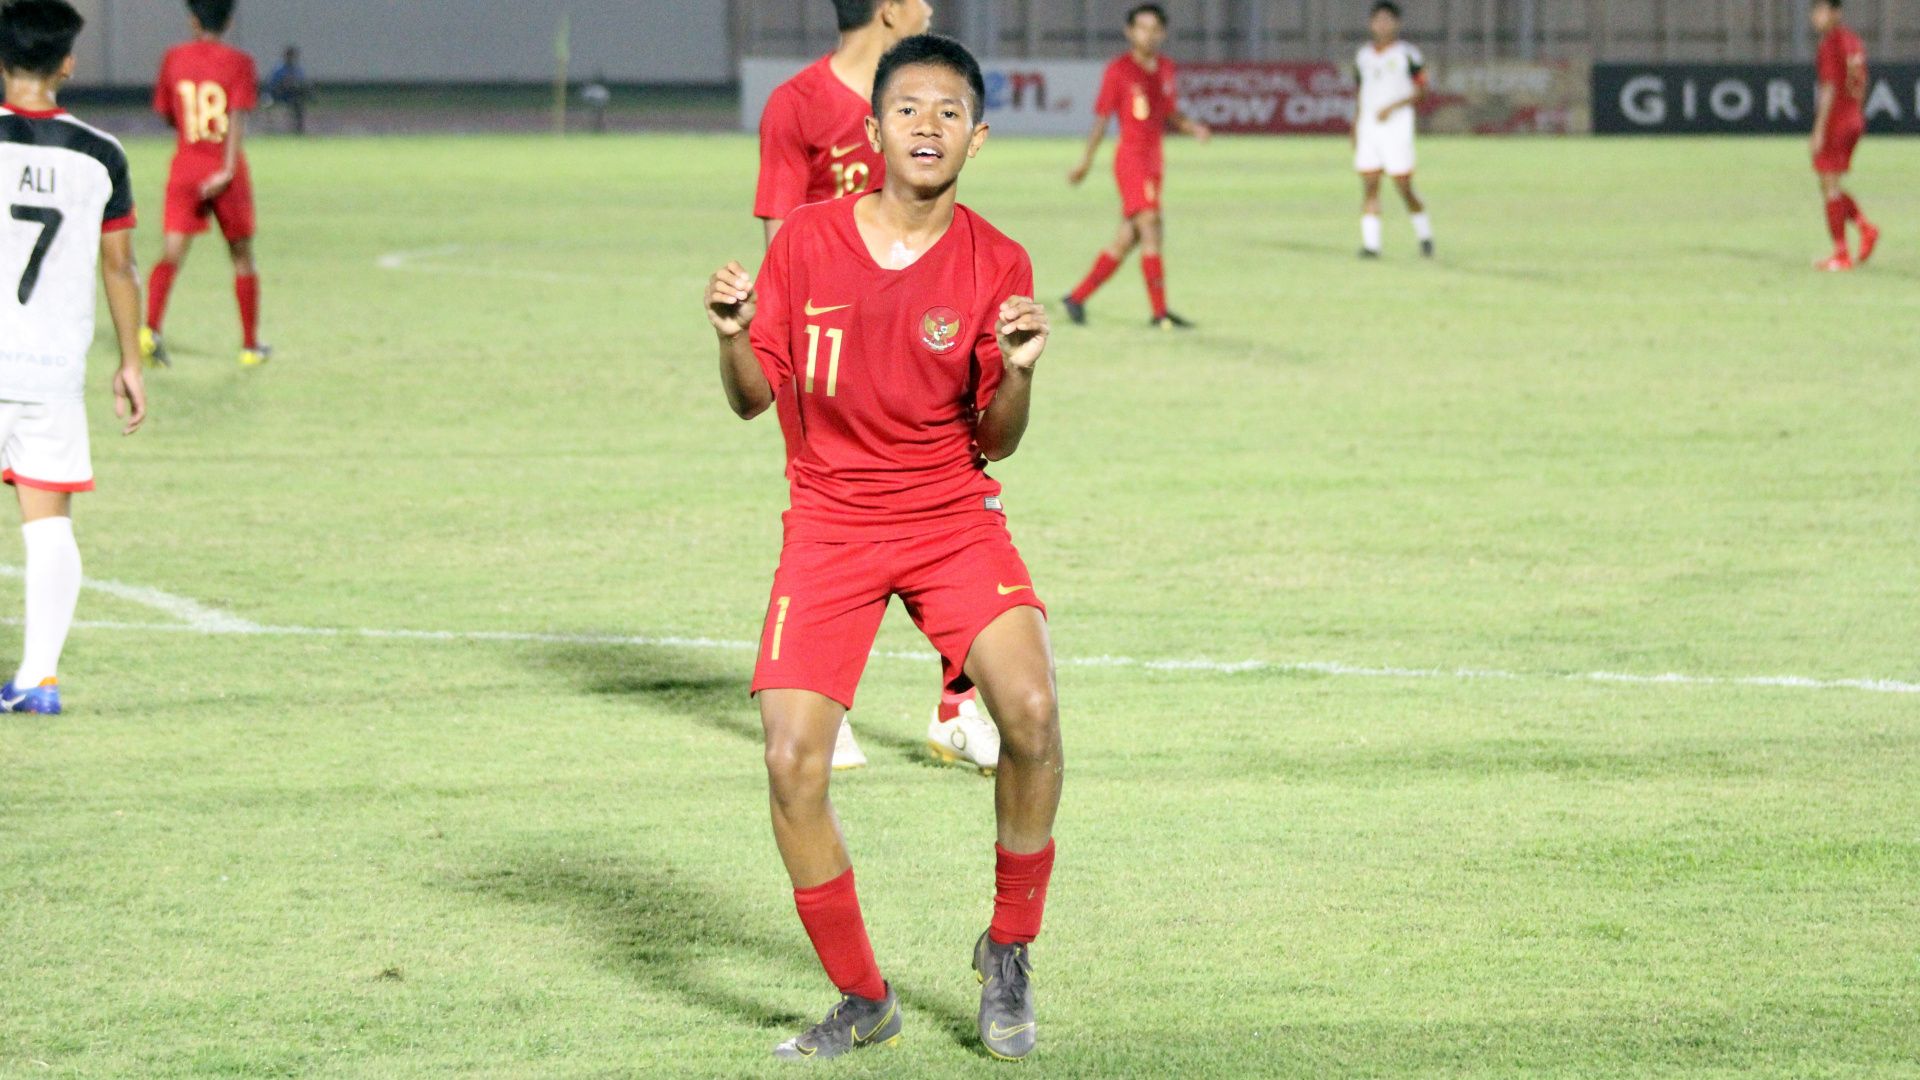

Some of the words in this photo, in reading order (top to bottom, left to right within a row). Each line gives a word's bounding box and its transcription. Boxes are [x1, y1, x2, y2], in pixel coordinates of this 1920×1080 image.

[177, 80, 230, 143] 18
[1619, 75, 1920, 125] GIORA
[19, 165, 55, 193] ALI
[10, 203, 64, 305] 7
[804, 324, 843, 397] 11
[771, 596, 791, 661] 1
